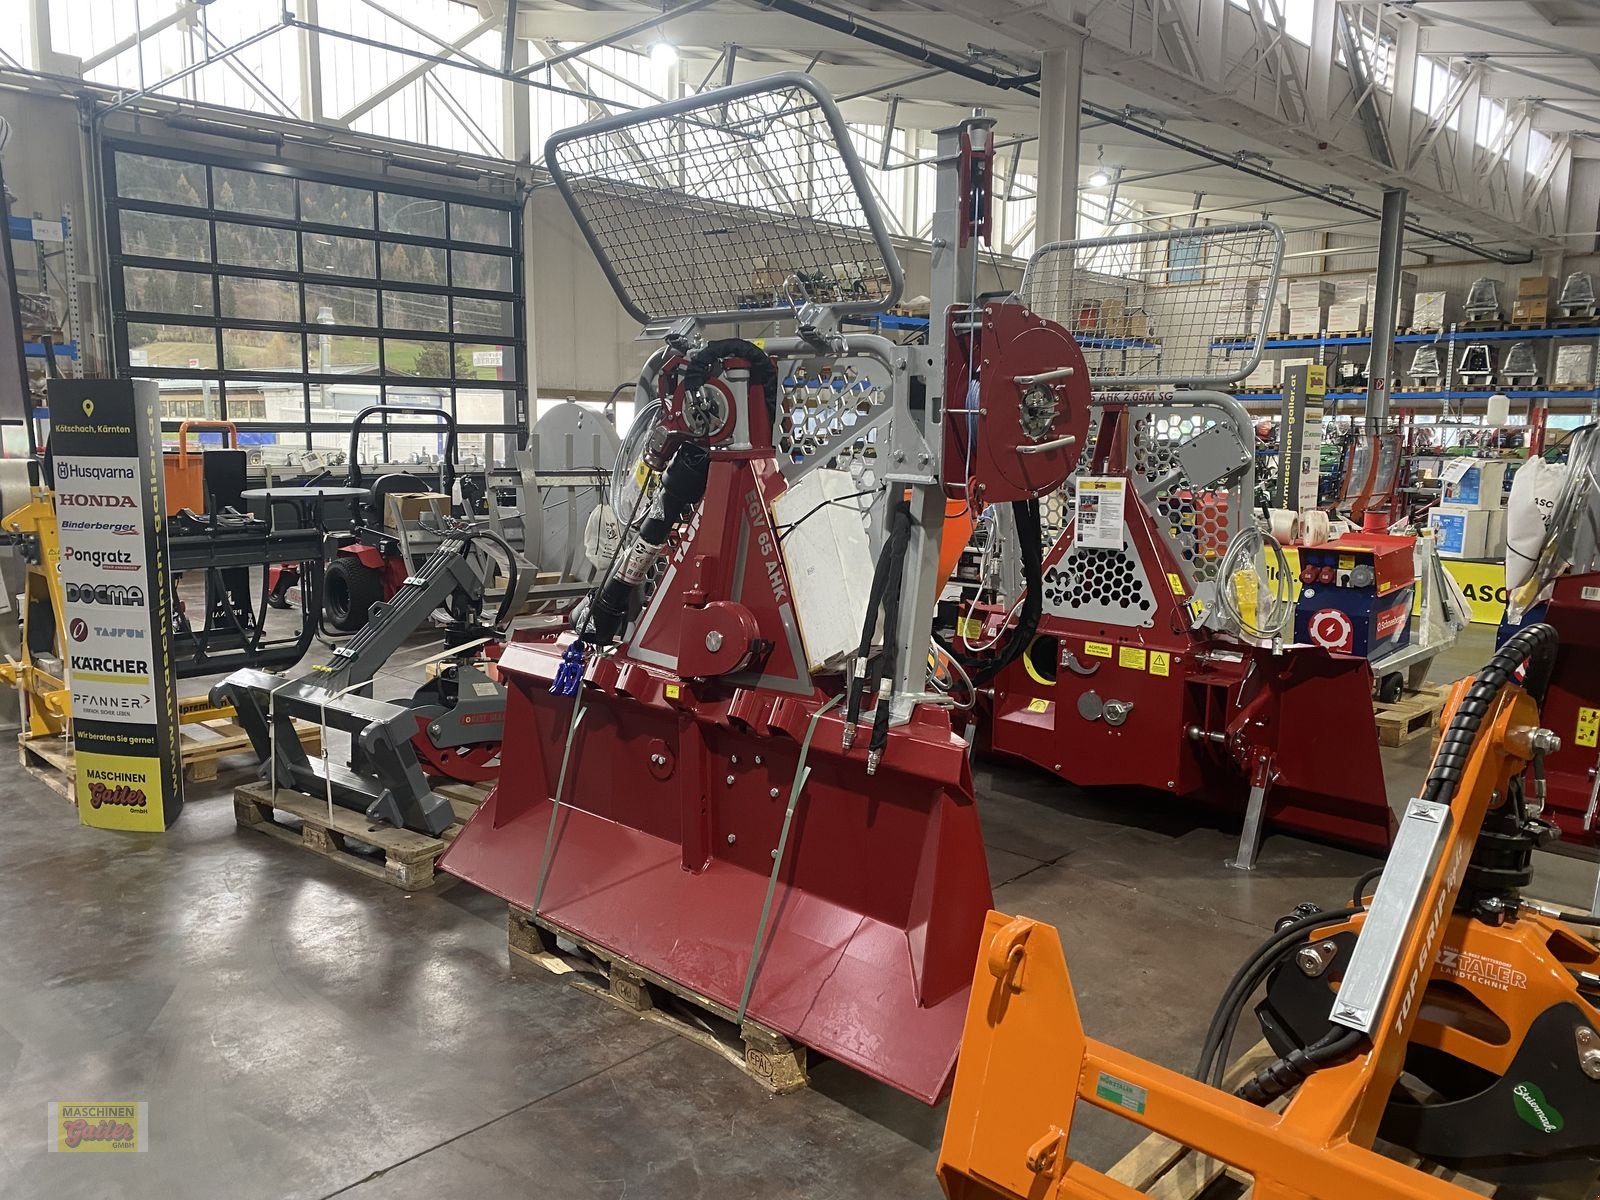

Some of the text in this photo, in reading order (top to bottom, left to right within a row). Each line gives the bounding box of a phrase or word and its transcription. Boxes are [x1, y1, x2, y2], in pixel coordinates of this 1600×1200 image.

[1098, 392, 1119, 402] AHK
[1123, 391, 1155, 402] 2.05M
[1158, 391, 1174, 401] SG
[55, 424, 131, 434] Kötschach, Kärnten
[69, 463, 134, 480] Husqvarna
[59, 494, 138, 508] HONDA
[61, 520, 136, 532] Binderberger
[745, 490, 787, 602] EGV 65 AHK
[64, 546, 132, 567] Pongratz
[66, 582, 145, 607] DOCMA
[147, 404, 178, 797] www.maschinen-gailer.at
[94, 626, 144, 639] TAJFUN
[71, 656, 149, 674] KÄRCHER
[74, 694, 141, 709] PFANNER
[77, 730, 155, 745] Wir beraten Sie gerne!
[86, 769, 146, 783] MASCHINEN
[88, 782, 147, 809] Gailer
[1395, 968, 1419, 1035] TOP
[1418, 888, 1447, 972] GRIP
[1440, 966, 1509, 992] LANDTECHNIK
[1513, 1085, 1557, 1133] Steiermark
